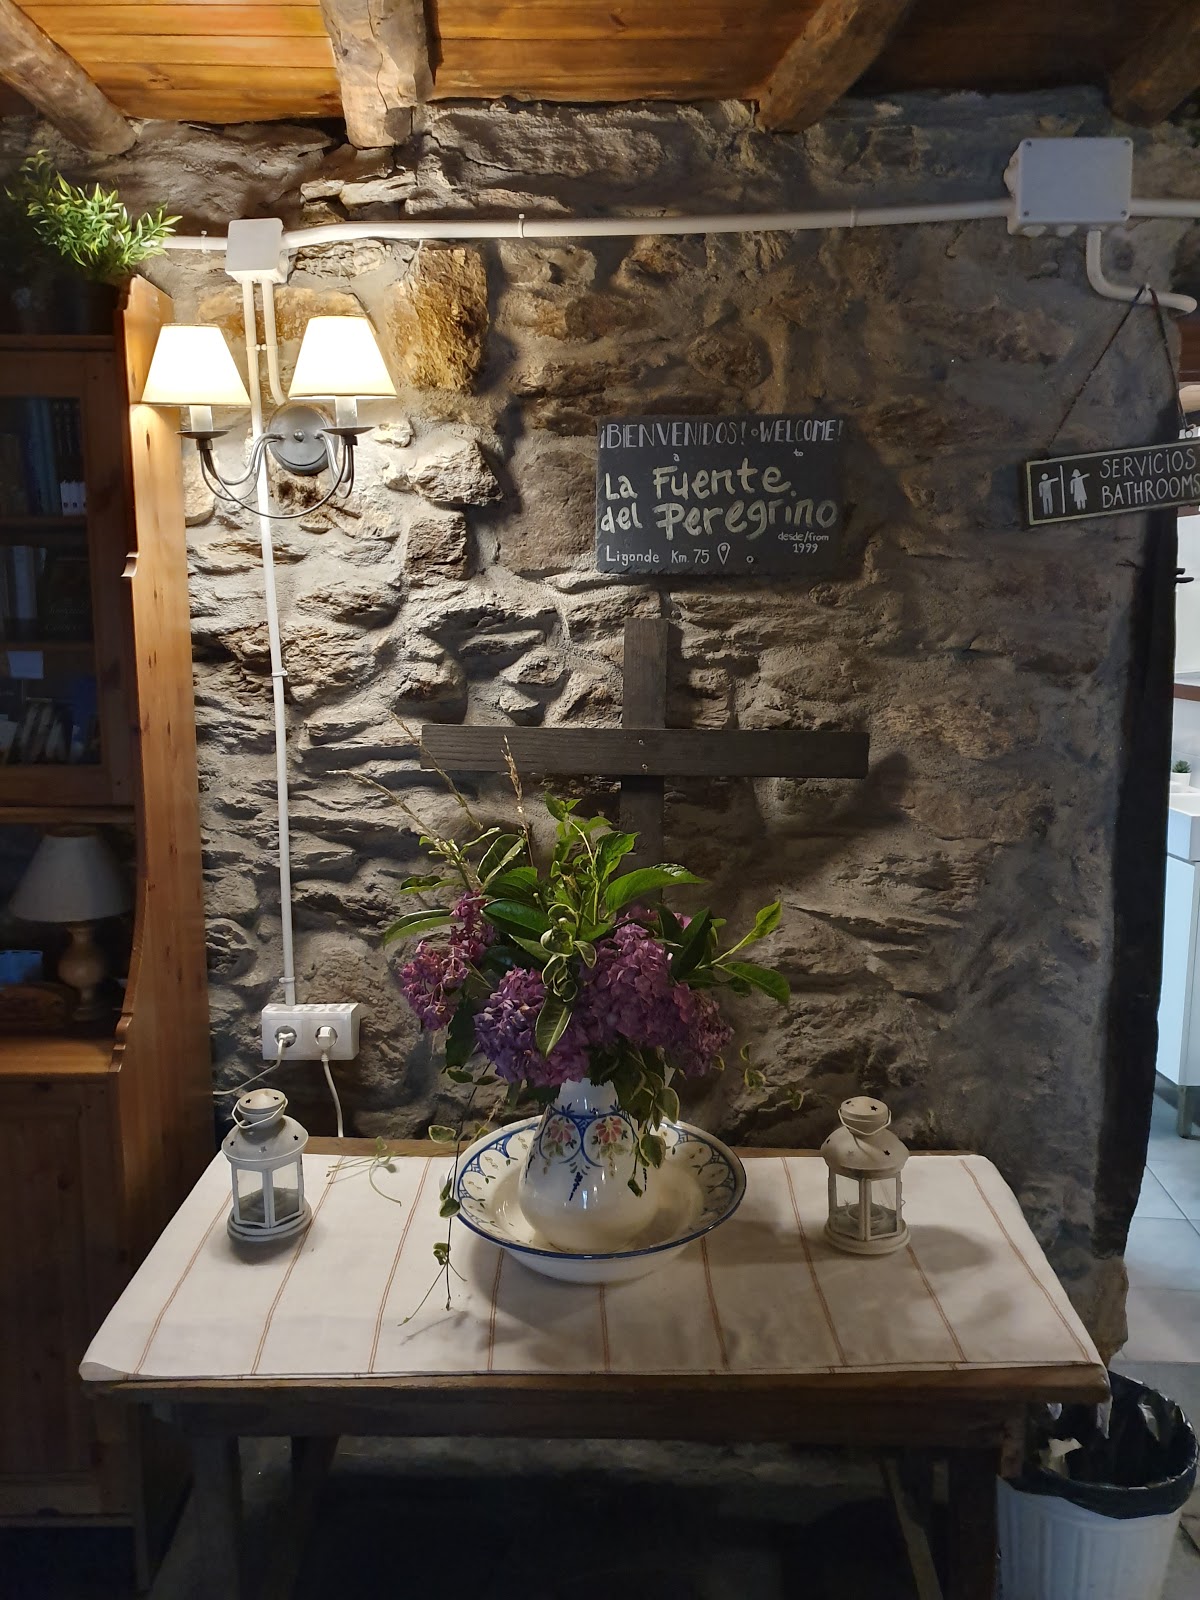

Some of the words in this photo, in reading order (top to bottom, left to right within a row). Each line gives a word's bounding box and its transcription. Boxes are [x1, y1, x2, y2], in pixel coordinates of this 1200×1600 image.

[793, 448, 804, 457] to
[605, 472, 638, 500] La
[1102, 474, 1200, 508] BATHROOMS
[600, 502, 643, 534] del
[652, 490, 838, 541] Peregrino
[777, 532, 829, 542] desde/from
[606, 545, 660, 566] Ligonde
[693, 549, 710, 564] 75
[792, 542, 819, 554] 1999
